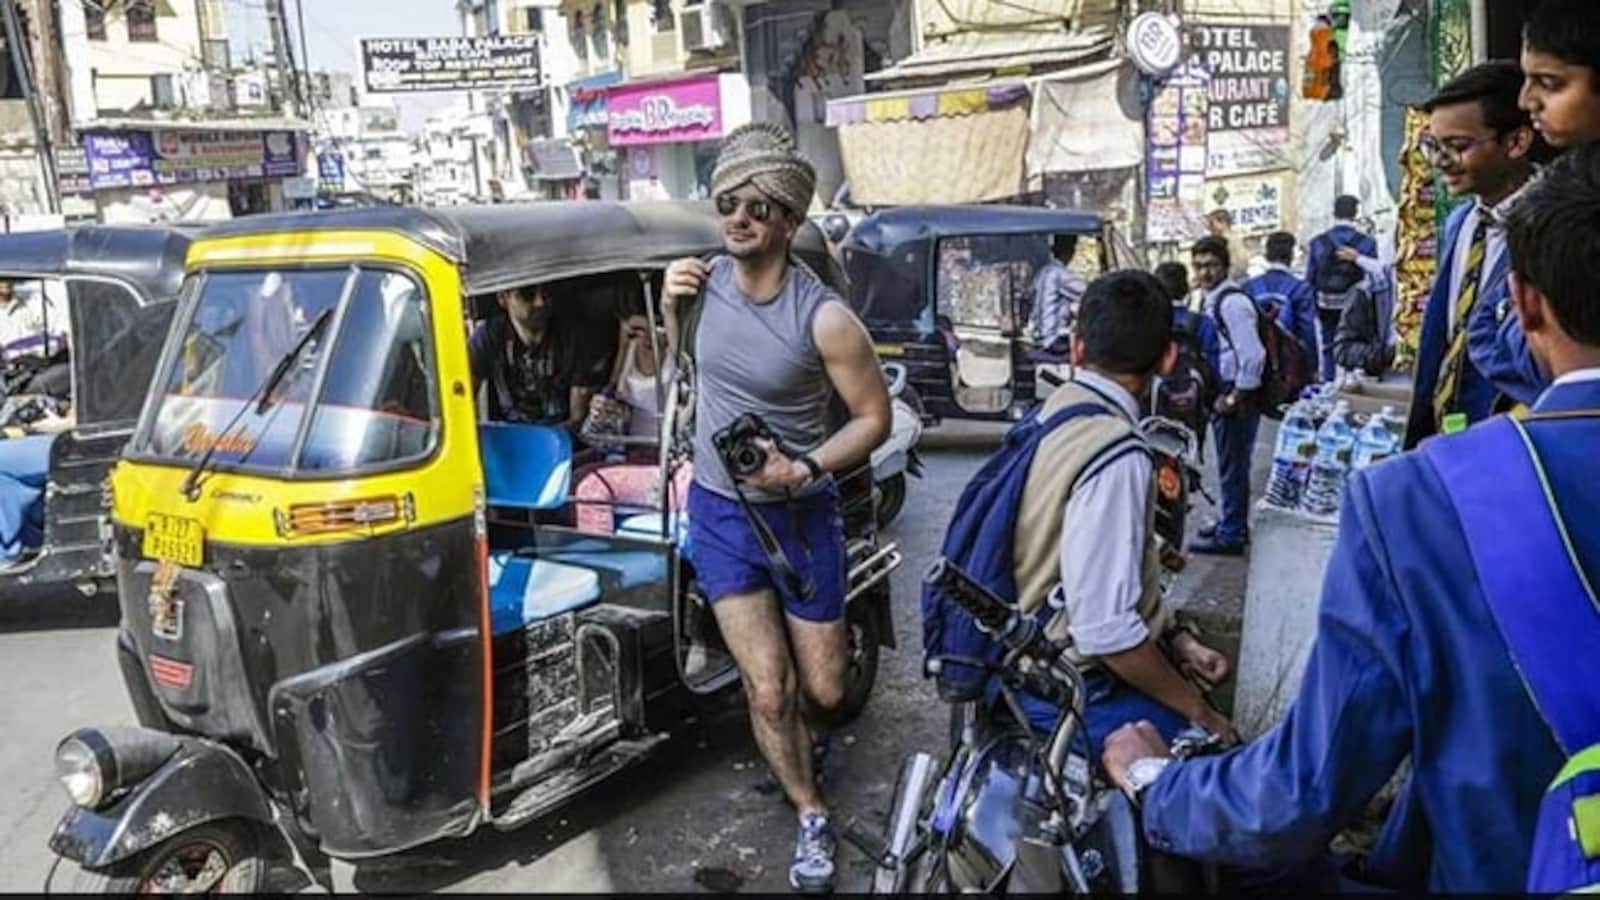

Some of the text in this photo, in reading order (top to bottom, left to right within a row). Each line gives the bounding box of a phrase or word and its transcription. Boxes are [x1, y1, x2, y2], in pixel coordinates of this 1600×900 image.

[367, 39, 423, 53] HOTEL
[475, 36, 536, 50] PALACE
[1193, 27, 1257, 49] OTEL
[1207, 51, 1284, 74] PALACE
[1207, 77, 1270, 101] AURANT
[1229, 99, 1279, 127] CAFÉ
